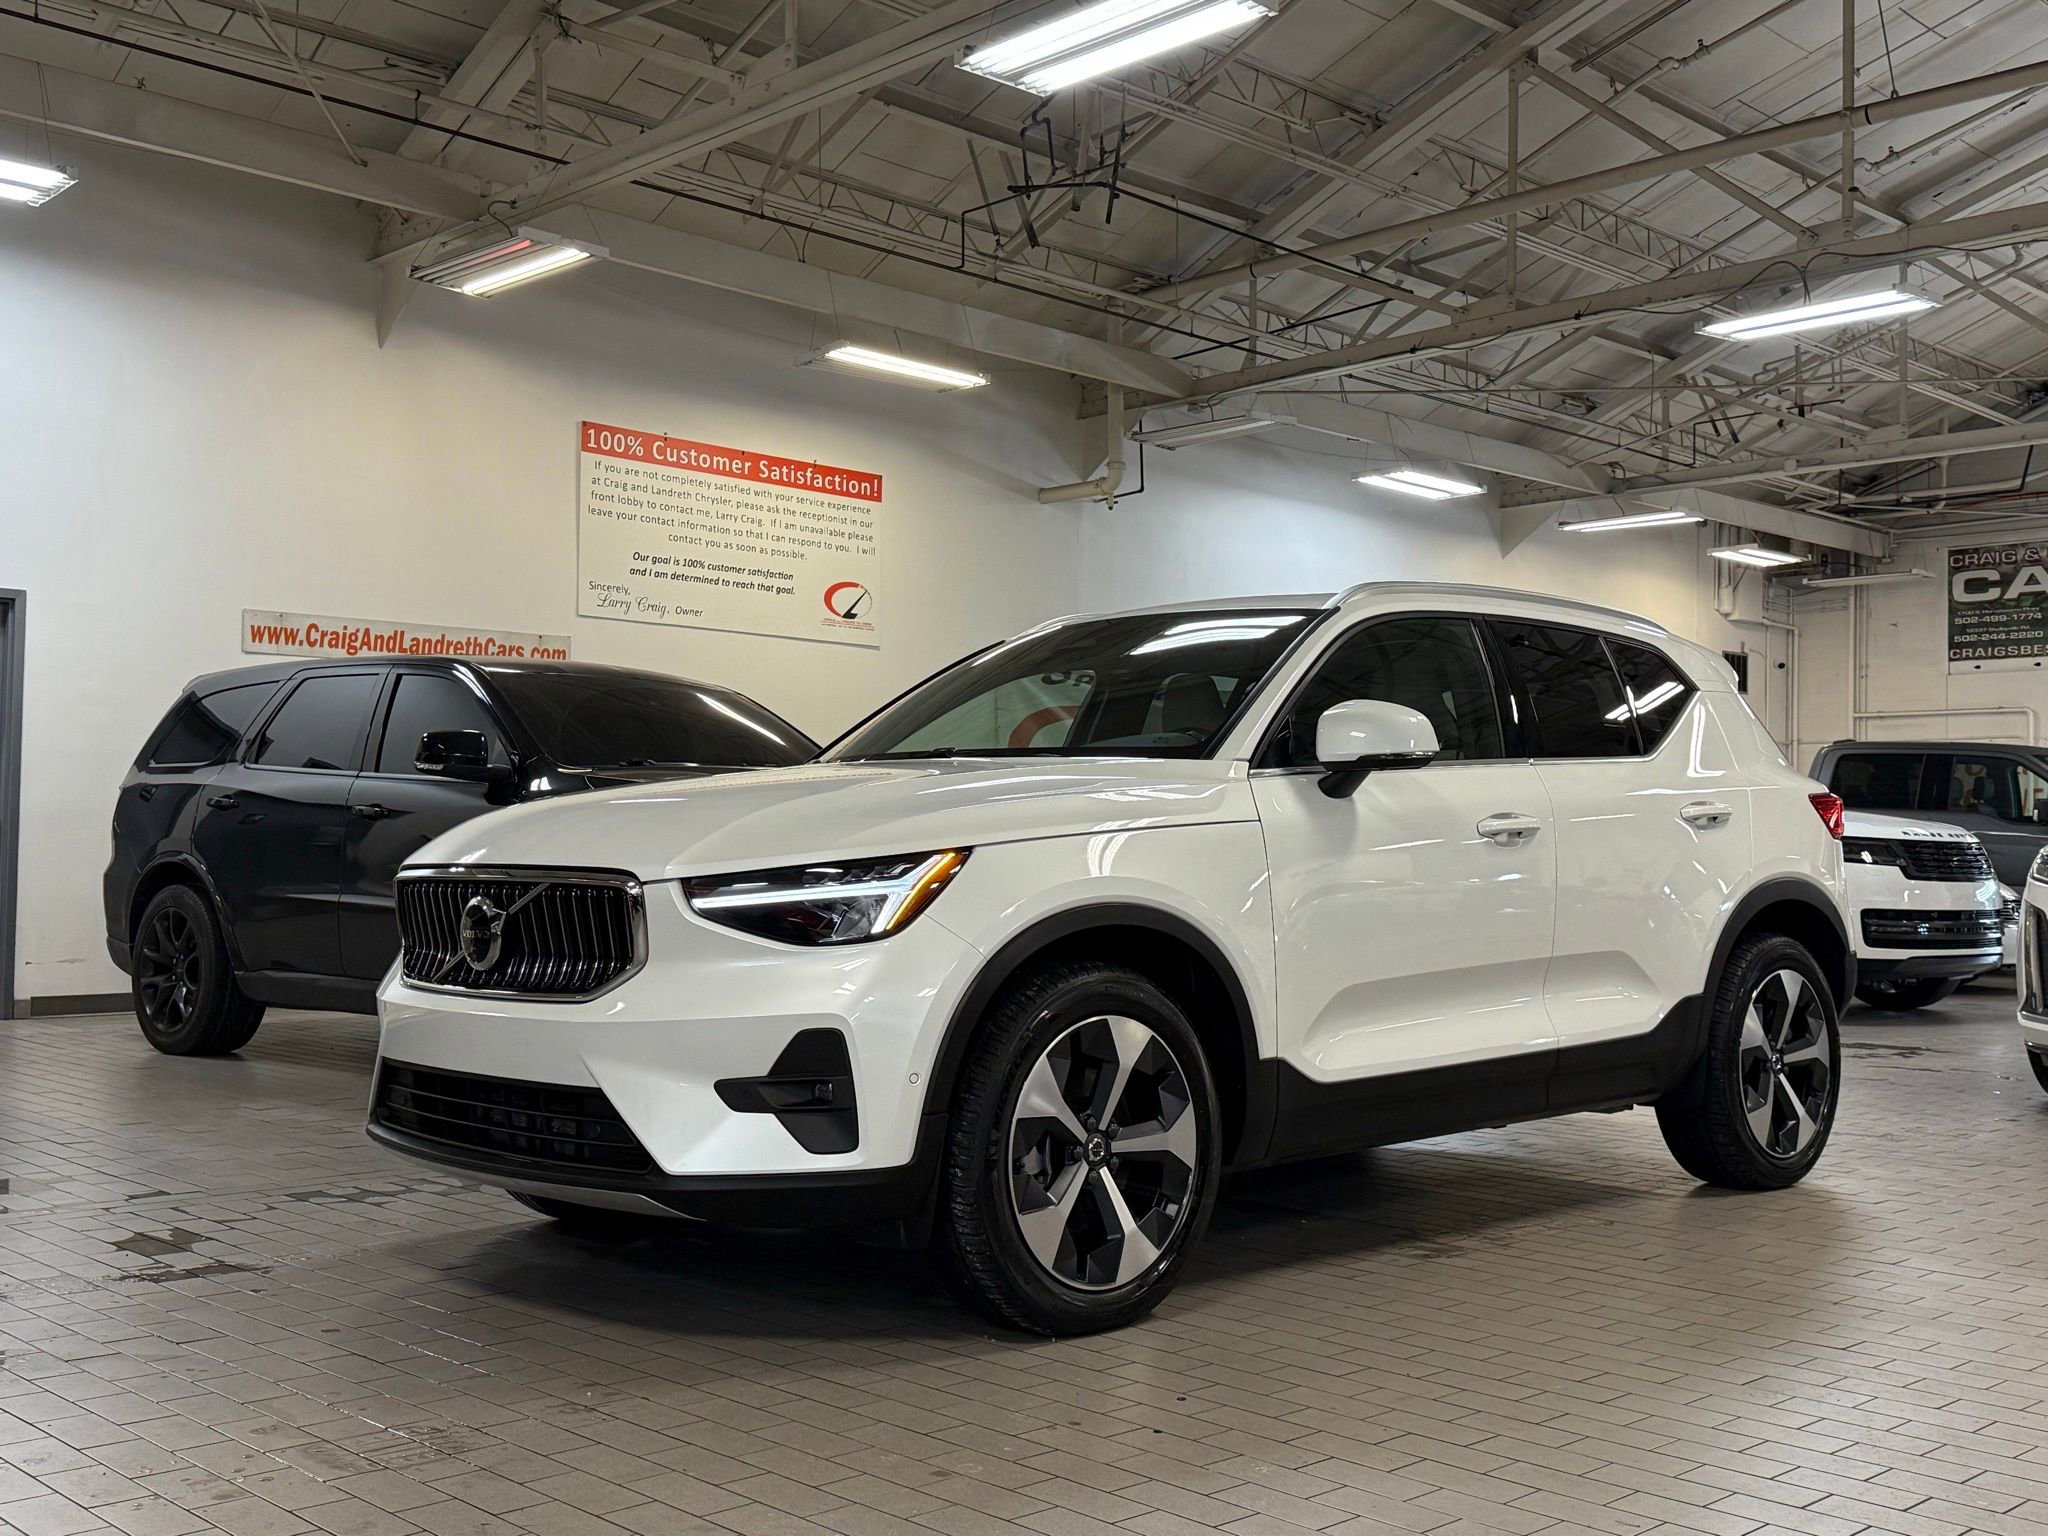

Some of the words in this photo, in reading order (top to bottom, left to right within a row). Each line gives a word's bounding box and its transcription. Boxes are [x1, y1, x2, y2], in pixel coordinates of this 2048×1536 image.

[588, 429, 644, 456] 100%
[653, 441, 752, 474] Customer
[759, 460, 878, 496] Satisfaction!
[594, 460, 602, 470] If
[604, 464, 622, 474] you
[624, 467, 640, 477] are
[642, 470, 658, 480] not
[661, 474, 712, 490] completely
[714, 482, 751, 495] satisfied
[753, 489, 772, 499] with
[774, 493, 794, 502] your
[796, 496, 825, 508] service
[827, 501, 871, 515] experience
[591, 477, 601, 486] at
[604, 477, 628, 492] Craig
[630, 483, 648, 493] and
[651, 484, 692, 500] Landreth
[695, 492, 734, 508] Chrysler,
[736, 499, 764, 512] please
[766, 504, 780, 514] ask
[783, 506, 797, 517] the
[799, 511, 848, 525] receptionist
[850, 517, 858, 526] in
[859, 520, 873, 528] our
[591, 489, 615, 503] front
[617, 494, 644, 509] lobby
[646, 500, 657, 510] to
[659, 503, 694, 516] contact
[696, 509, 713, 519] me,
[716, 510, 739, 524] Larry
[740, 514, 765, 528] Craig.
[770, 518, 777, 528] If
[784, 522, 797, 530] am
[799, 525, 846, 538] unavailable
[848, 530, 874, 543] please
[588, 504, 613, 518] leave
[615, 511, 638, 521] your
[640, 515, 675, 527] contact
[678, 518, 731, 535] information
[733, 529, 744, 537] so
[746, 528, 763, 540] that
[771, 534, 786, 543] can
[788, 537, 822, 548] respond
[824, 541, 833, 550] to
[834, 544, 852, 552] you.
[861, 547, 876, 556] will
[668, 534, 702, 546] contact
[705, 539, 721, 548] you
[723, 542, 734, 550] as
[736, 543, 757, 553] soon
[759, 547, 768, 555] as
[770, 548, 807, 560] possible.
[1950, 550, 2017, 567] CRAIG
[2024, 548, 2040, 561] &
[632, 551, 650, 562] Our
[651, 555, 672, 565] goal
[673, 556, 681, 566] is
[682, 558, 706, 570] 100%
[707, 563, 746, 575] customer
[747, 568, 794, 581] satisfaction
[629, 567, 647, 576] and
[654, 570, 669, 580] am
[670, 571, 720, 586] determined
[721, 578, 731, 587] to
[732, 580, 755, 590] reach
[757, 582, 774, 593] that
[775, 586, 796, 595] goal.
[596, 592, 632, 615] Larry
[675, 605, 704, 617] Owner
[1955, 612, 2042, 625] 502-499-1774
[1953, 630, 2044, 643] 502-244-2220
